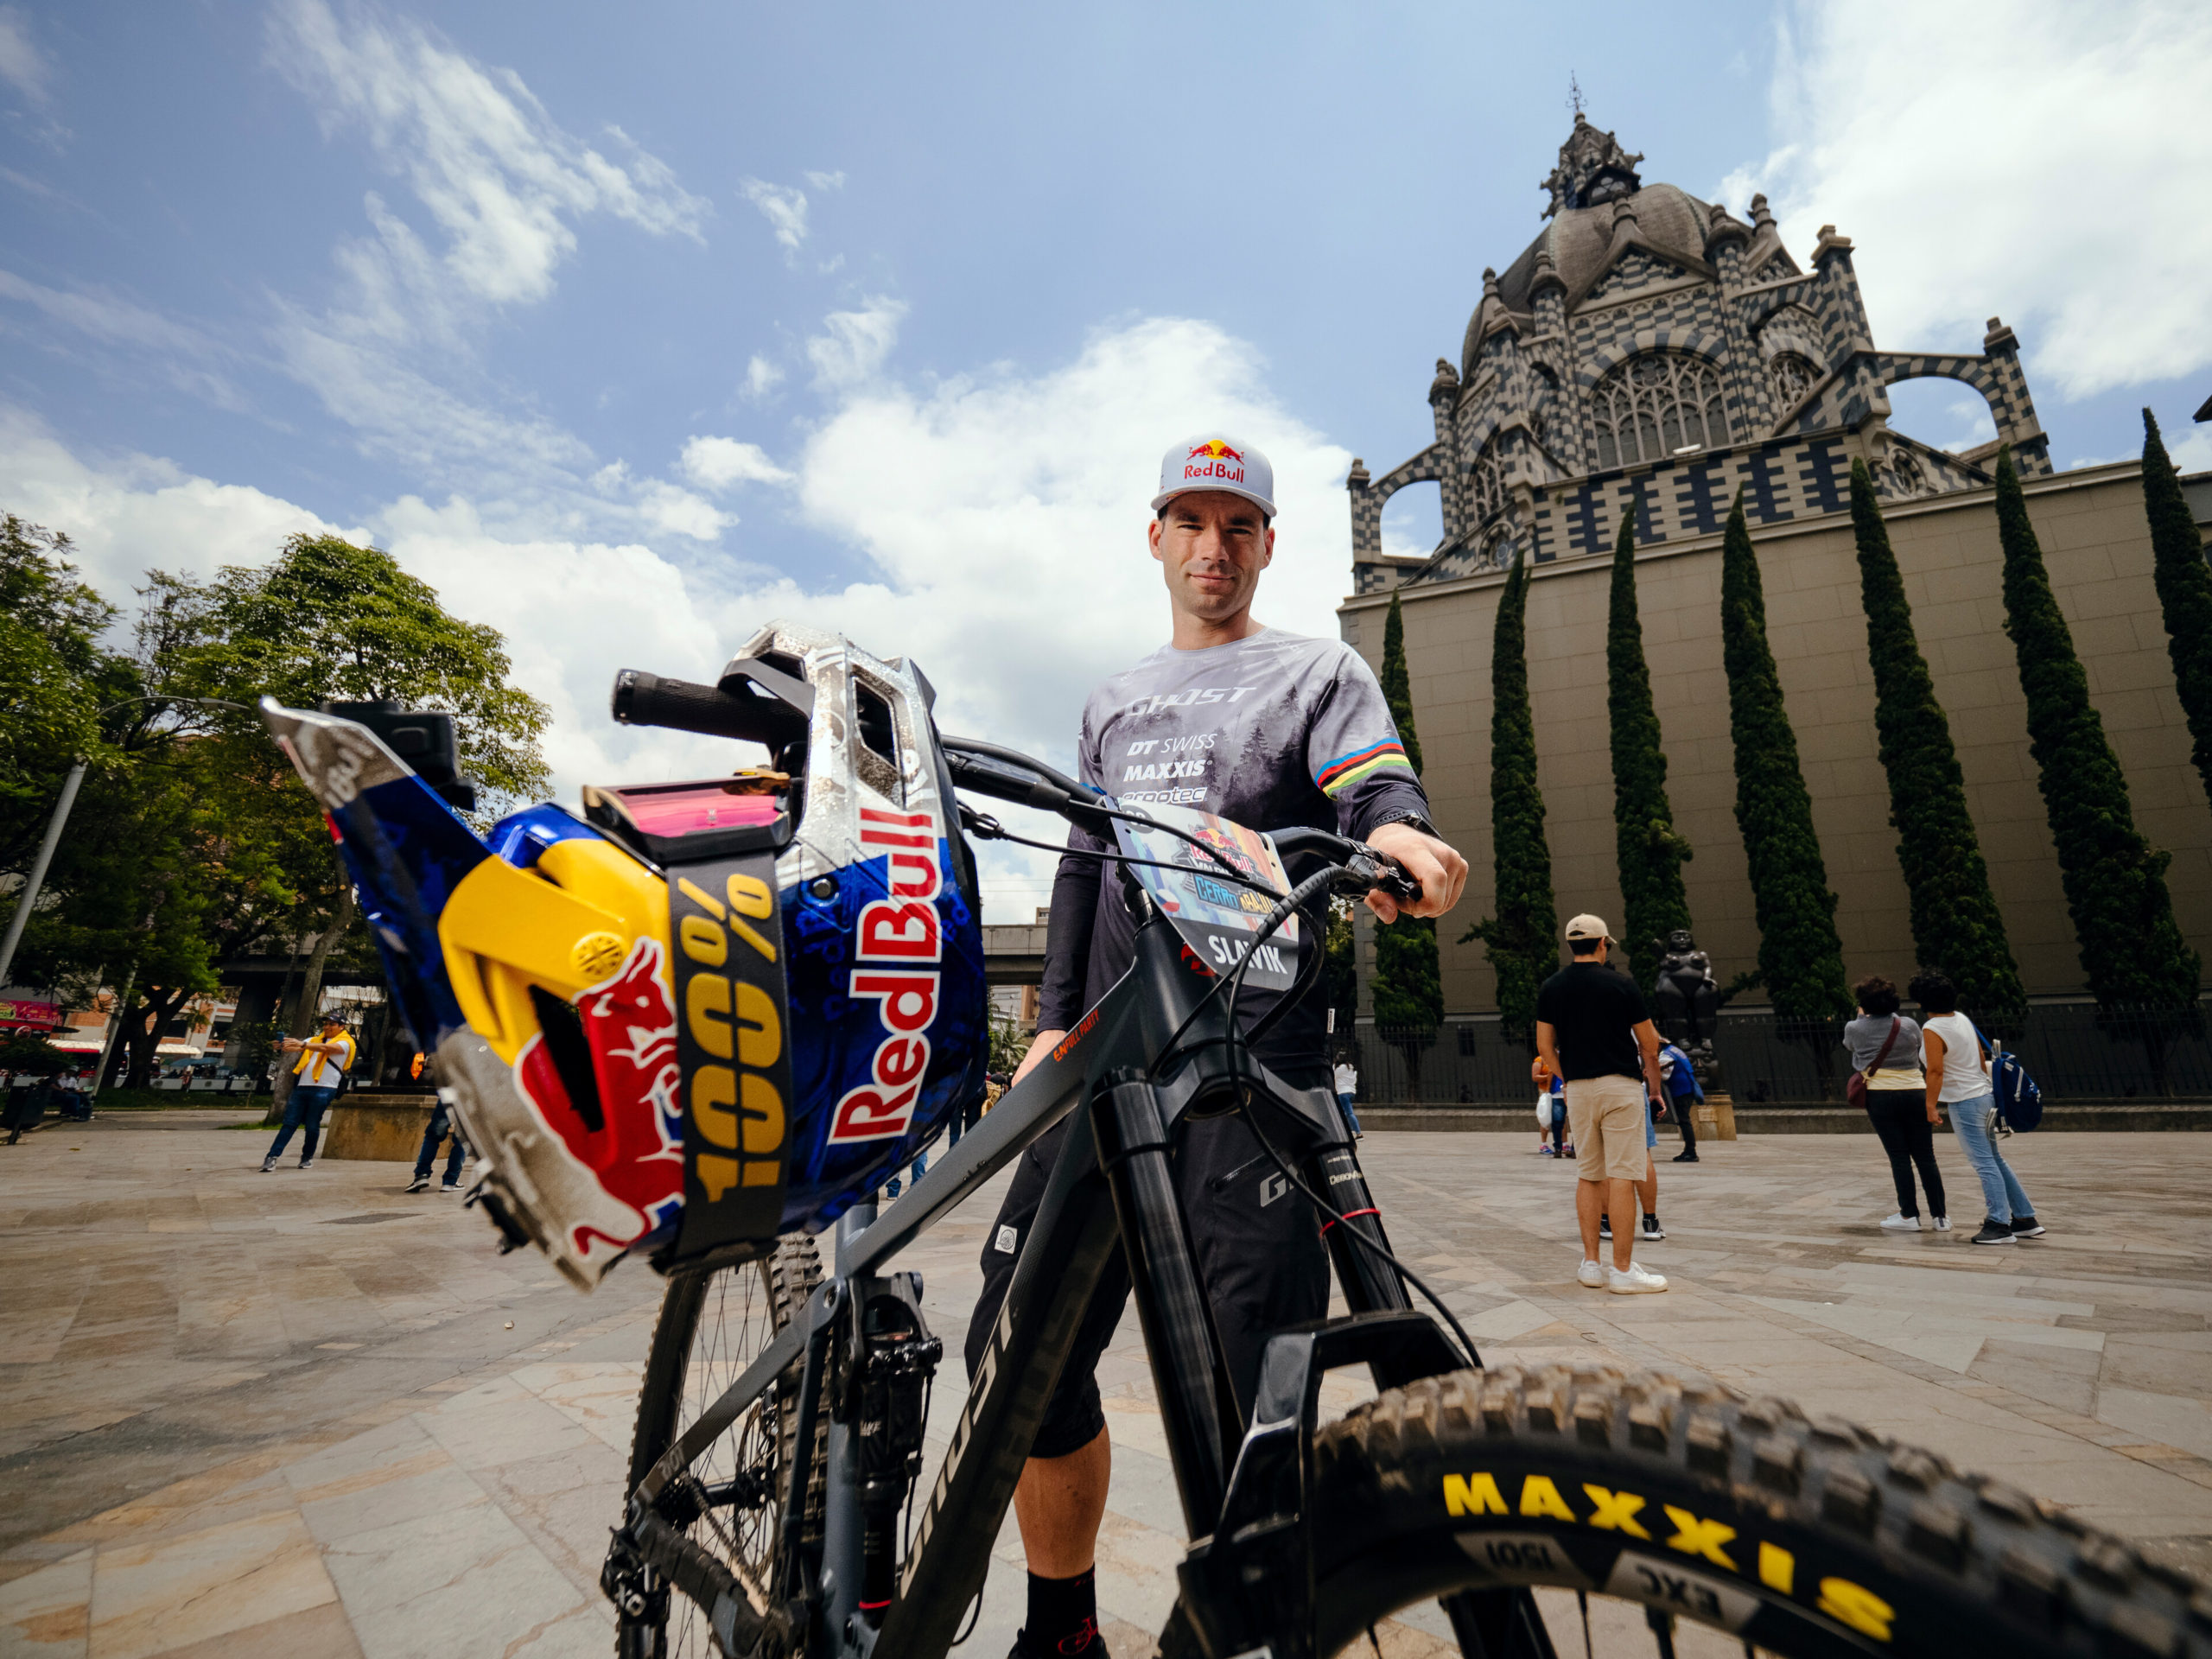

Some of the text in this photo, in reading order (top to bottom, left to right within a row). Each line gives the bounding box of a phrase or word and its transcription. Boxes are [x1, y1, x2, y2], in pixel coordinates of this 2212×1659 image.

[1185, 461, 1244, 484] Red Bull
[1125, 687, 1256, 716] GHOST
[1127, 734, 1217, 756] DT SWISS
[1123, 760, 1207, 782] MAXXIS
[855, 807, 944, 963] Bull
[678, 873, 785, 1203] 100%
[827, 970, 941, 1146] Red
[1442, 1472, 1896, 1642] MAXXIS
